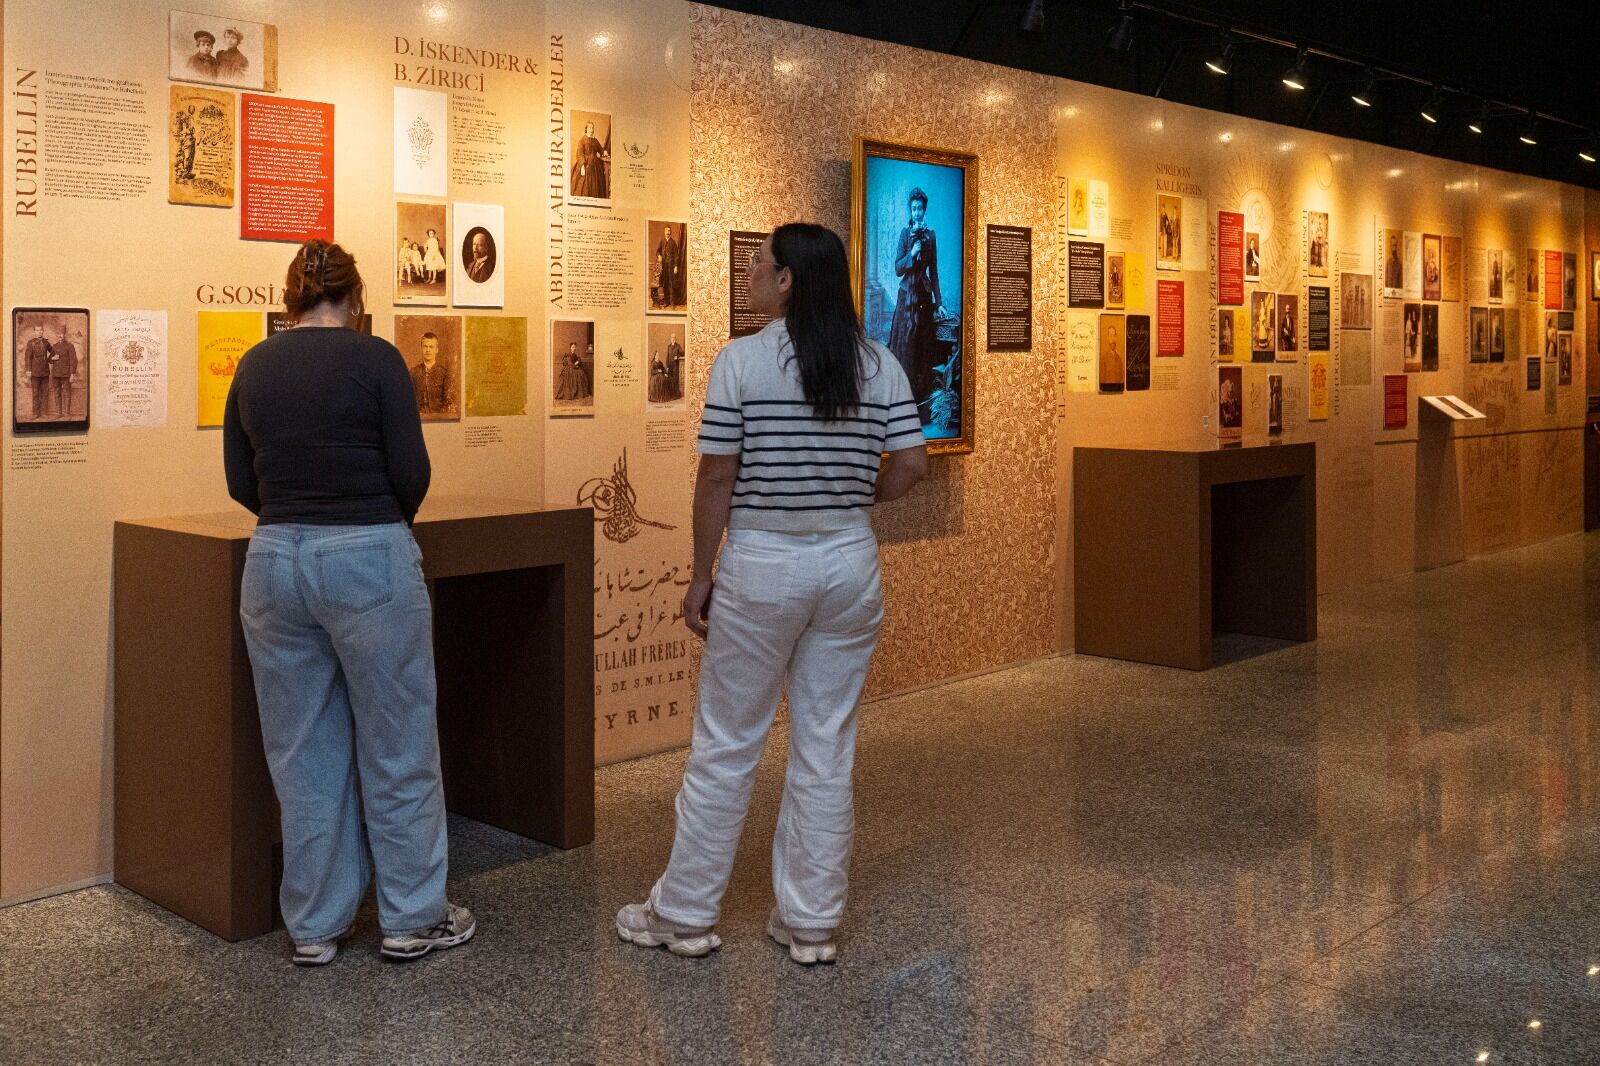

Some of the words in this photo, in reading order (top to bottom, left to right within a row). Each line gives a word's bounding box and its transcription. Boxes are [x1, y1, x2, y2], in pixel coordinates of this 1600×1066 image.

[394, 36, 414, 56] D.
[419, 37, 521, 73] İSKENDER
[524, 57, 539, 76] &
[394, 63, 412, 82] B.
[416, 65, 485, 92] ZİRBCİ
[547, 34, 564, 179] BİRADERLER
[12, 68, 38, 217] RUBELLİN
[550, 183, 564, 309] ABDULLAH
[594, 648, 636, 672] ULLAH
[611, 680, 627, 693] DE
[594, 701, 684, 731] YRNE.
